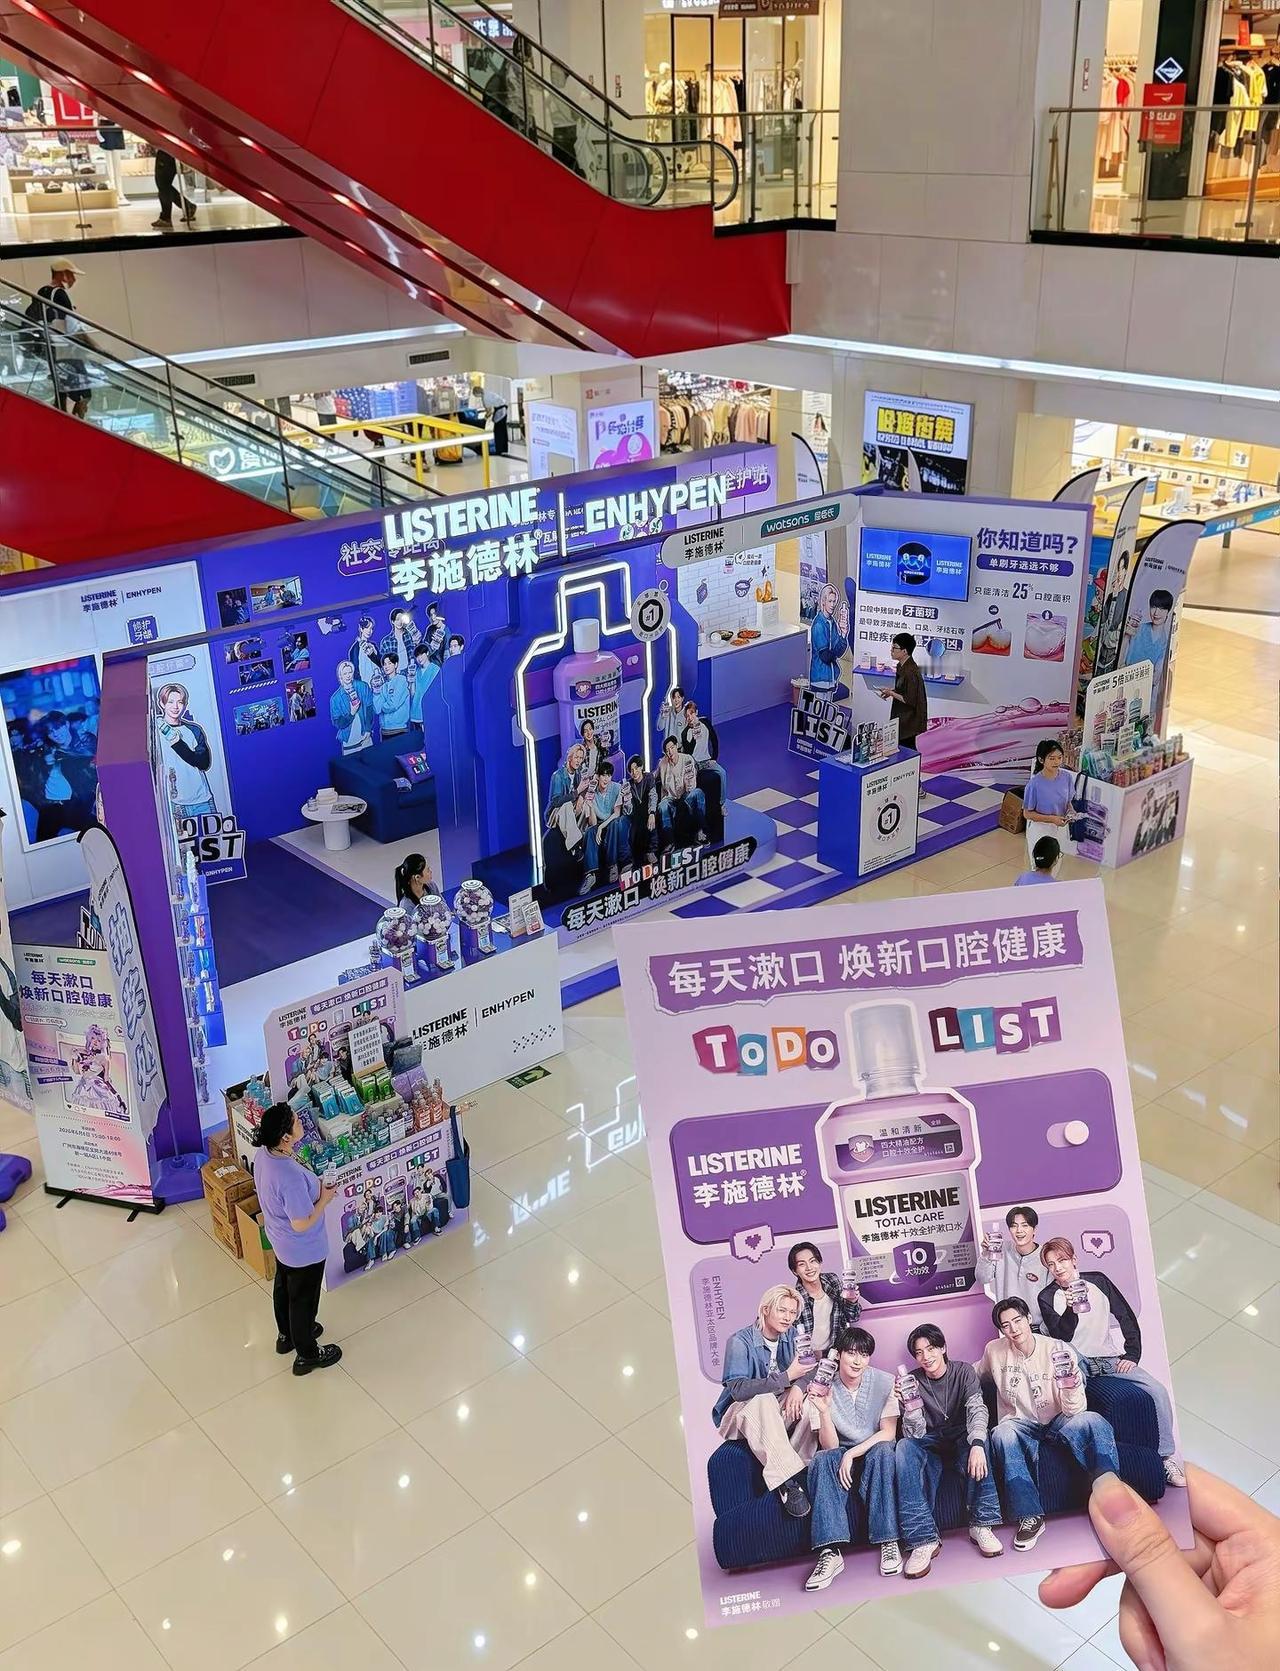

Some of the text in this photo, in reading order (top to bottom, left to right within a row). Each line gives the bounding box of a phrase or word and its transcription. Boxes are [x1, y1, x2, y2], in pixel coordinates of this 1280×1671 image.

[384, 487, 538, 550] LISTERINE
[584, 475, 727, 532] ENHYPEN
[684, 527, 724, 545] LISTERINE
[766, 513, 809, 533] watsons
[81, 586, 162, 603] LISTERINE ENHYPEN
[793, 709, 846, 752] LIST
[567, 887, 639, 929] 每天漱口
[650, 842, 750, 899] 焕新口腔健康
[669, 922, 1067, 998] 每天漱口 焕新口腔健康
[19, 984, 113, 1008] 焕新口腔健康
[31, 970, 93, 990] 每天漱口
[412, 988, 535, 1040] LISTERINE ENHYPEN
[938, 1006, 1054, 1049] LIST
[688, 1144, 803, 1177] LISTERINE
[854, 1186, 960, 1219] LISTERINE
[875, 1211, 945, 1229] TOTAL CARE
[902, 1248, 928, 1266] 10
[904, 1266, 931, 1277] 大功效
[712, 1275, 726, 1320] ENHYPEN
[720, 1590, 761, 1606] LISTERINE
